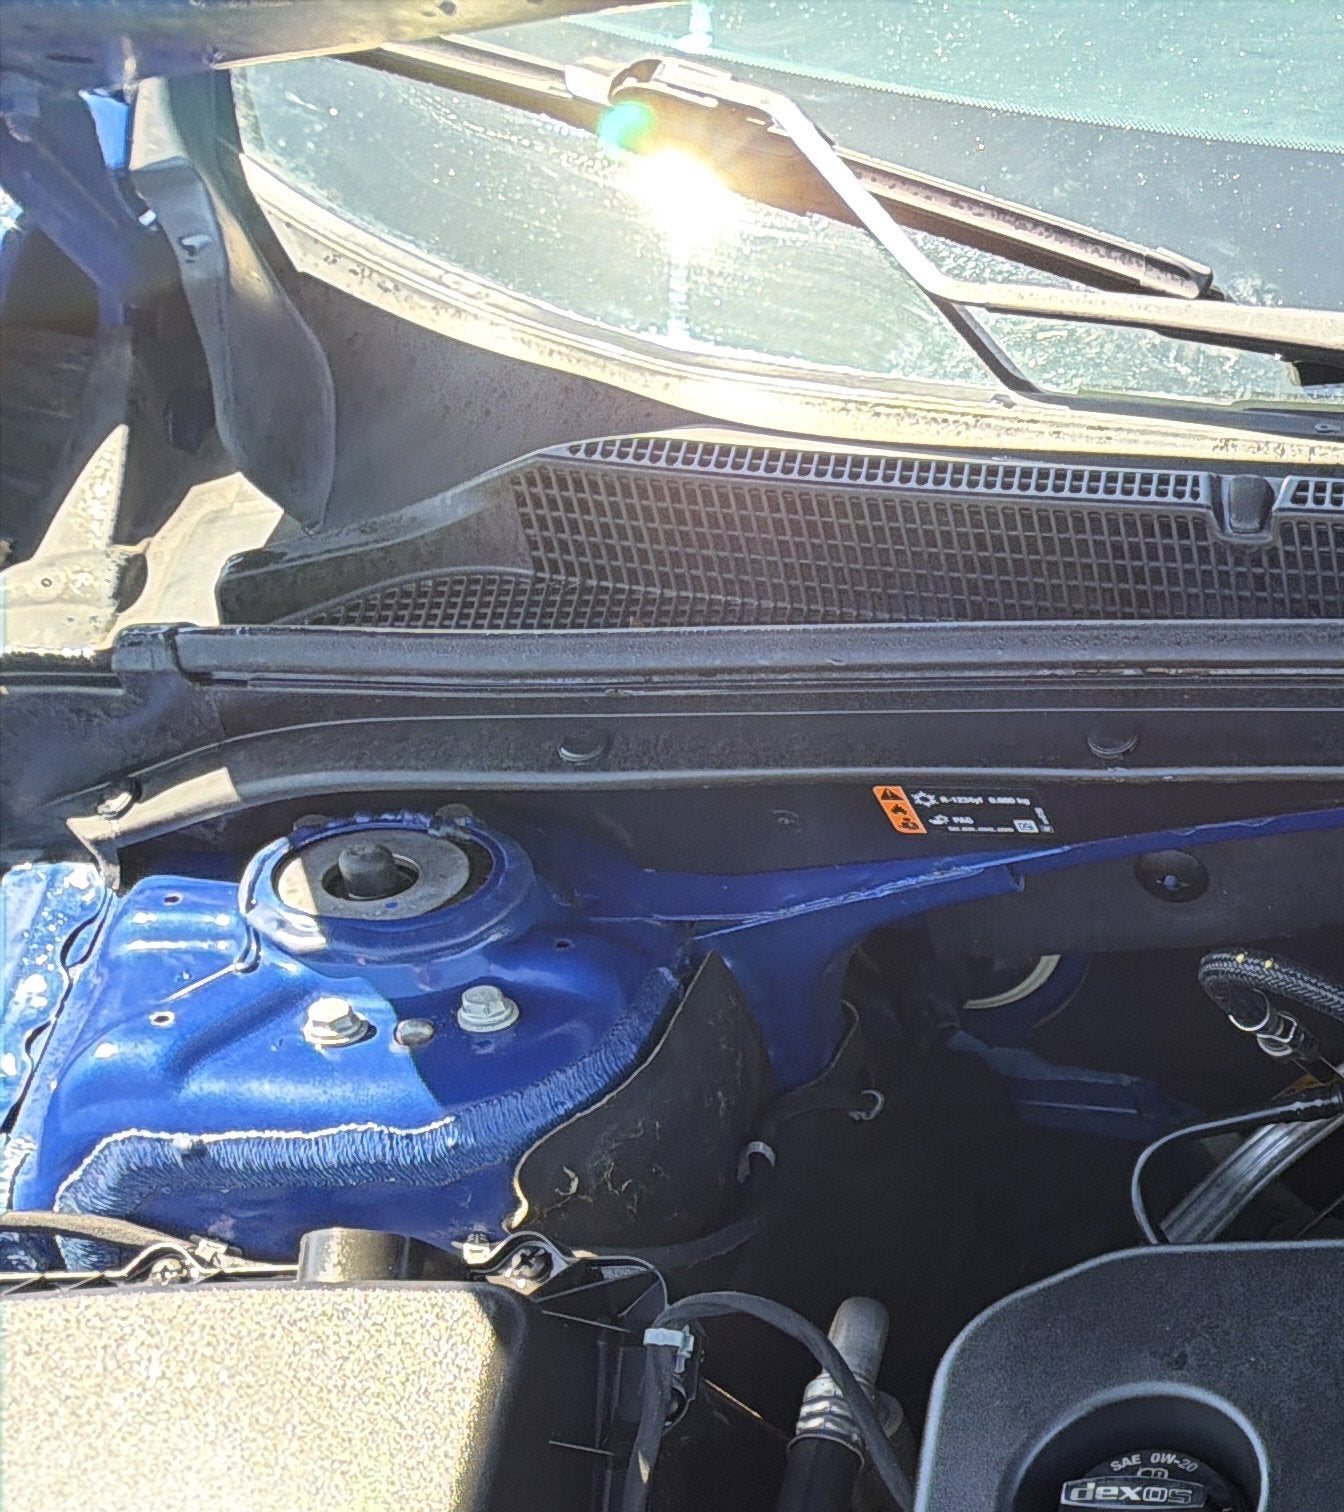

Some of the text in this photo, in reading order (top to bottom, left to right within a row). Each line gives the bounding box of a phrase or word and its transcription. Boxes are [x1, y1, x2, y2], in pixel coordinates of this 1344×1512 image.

[1110, 1452, 1199, 1472] SAE 0W-20
[1070, 1482, 1193, 1504] dexos
